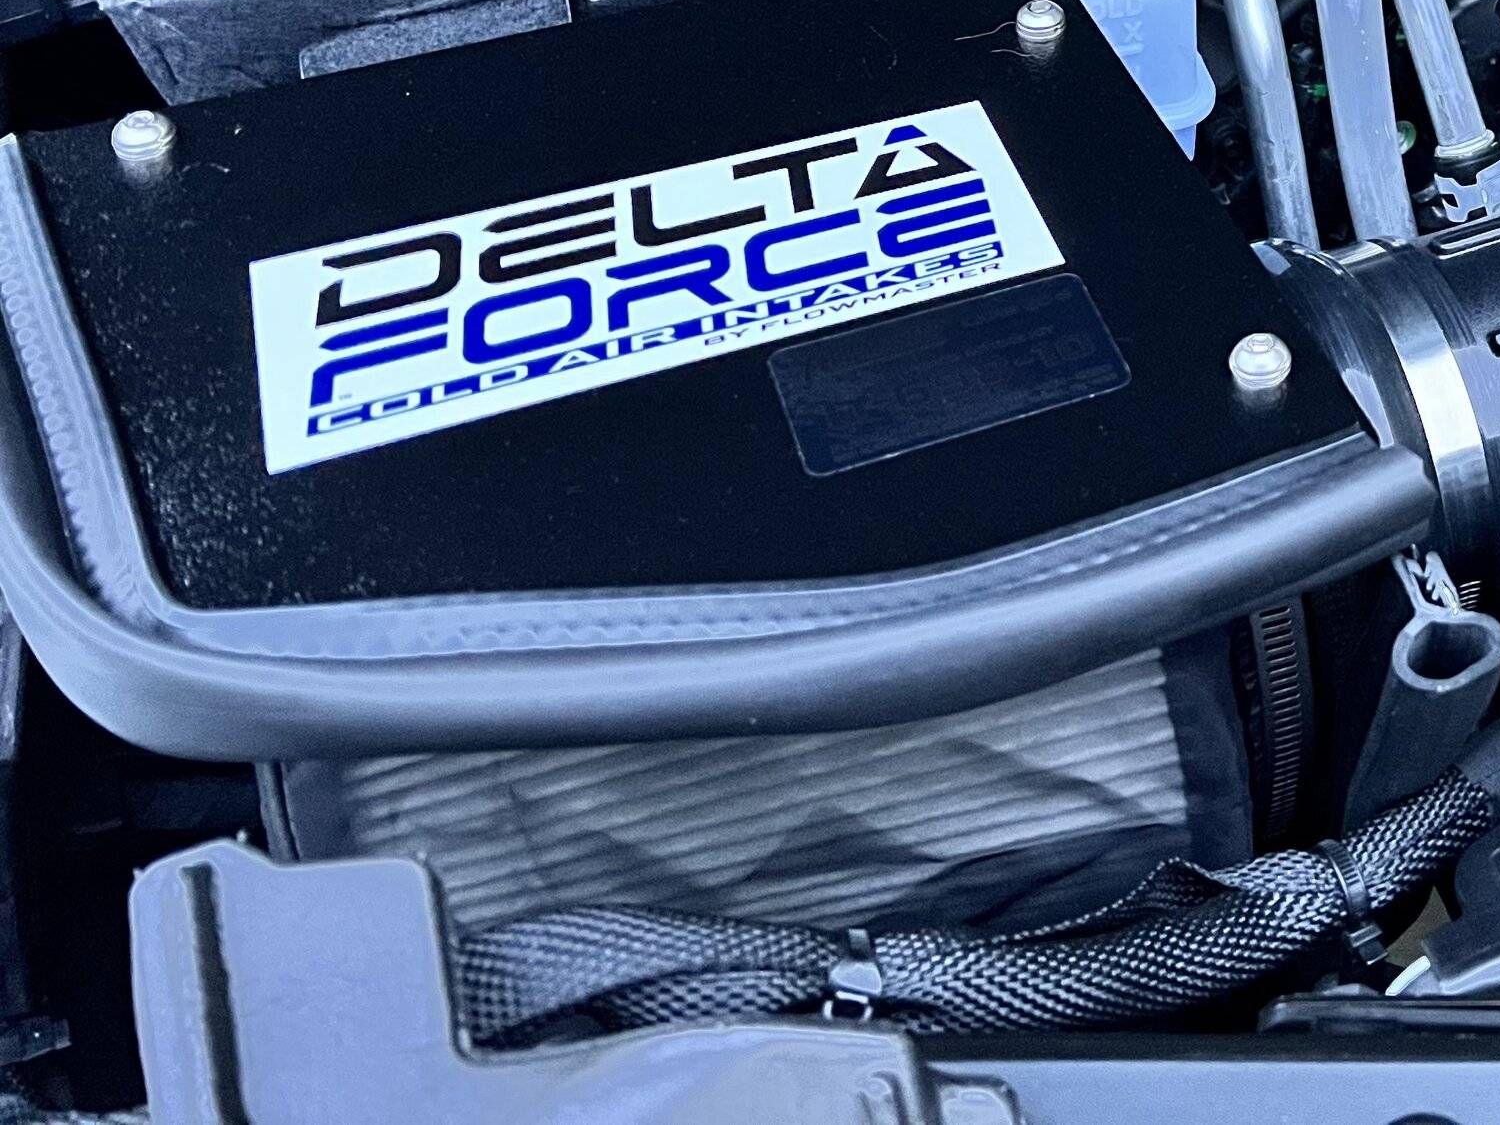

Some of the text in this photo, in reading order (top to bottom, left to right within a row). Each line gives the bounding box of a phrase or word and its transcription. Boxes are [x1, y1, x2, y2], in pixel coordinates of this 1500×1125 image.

[309, 177, 997, 409] FORCE
[315, 124, 977, 329] DELTA
[703, 330, 746, 347] BY
[760, 262, 1001, 332] FLOWMASTER
[316, 364, 529, 434] COLD
[548, 326, 678, 374] AIR
[699, 241, 1000, 333] INTAKES
